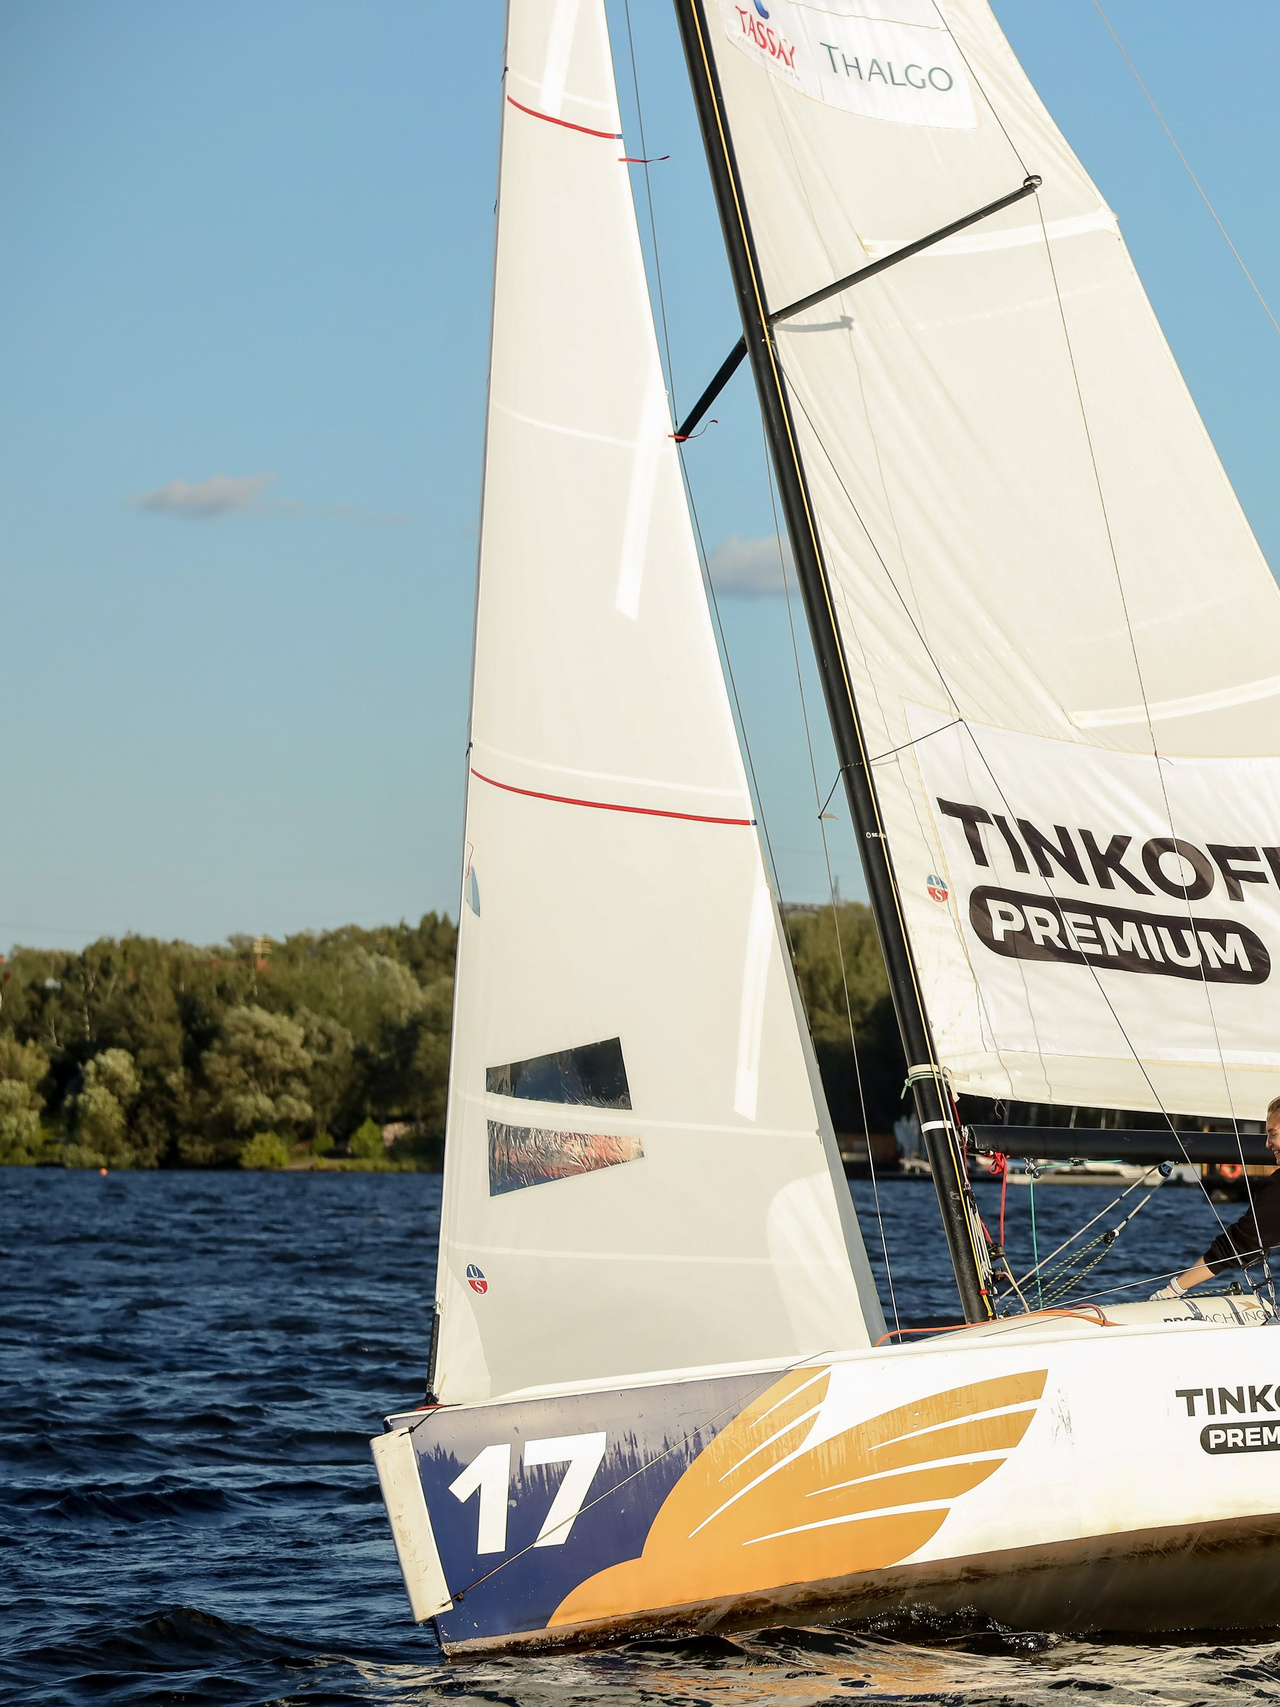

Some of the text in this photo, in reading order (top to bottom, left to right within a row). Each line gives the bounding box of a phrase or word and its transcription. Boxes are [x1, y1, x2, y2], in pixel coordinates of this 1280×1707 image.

[735, 5, 796, 70] TASSAY
[819, 41, 954, 92] THALGO
[985, 898, 1254, 973] PREMIUM
[448, 1431, 607, 1555] 17
